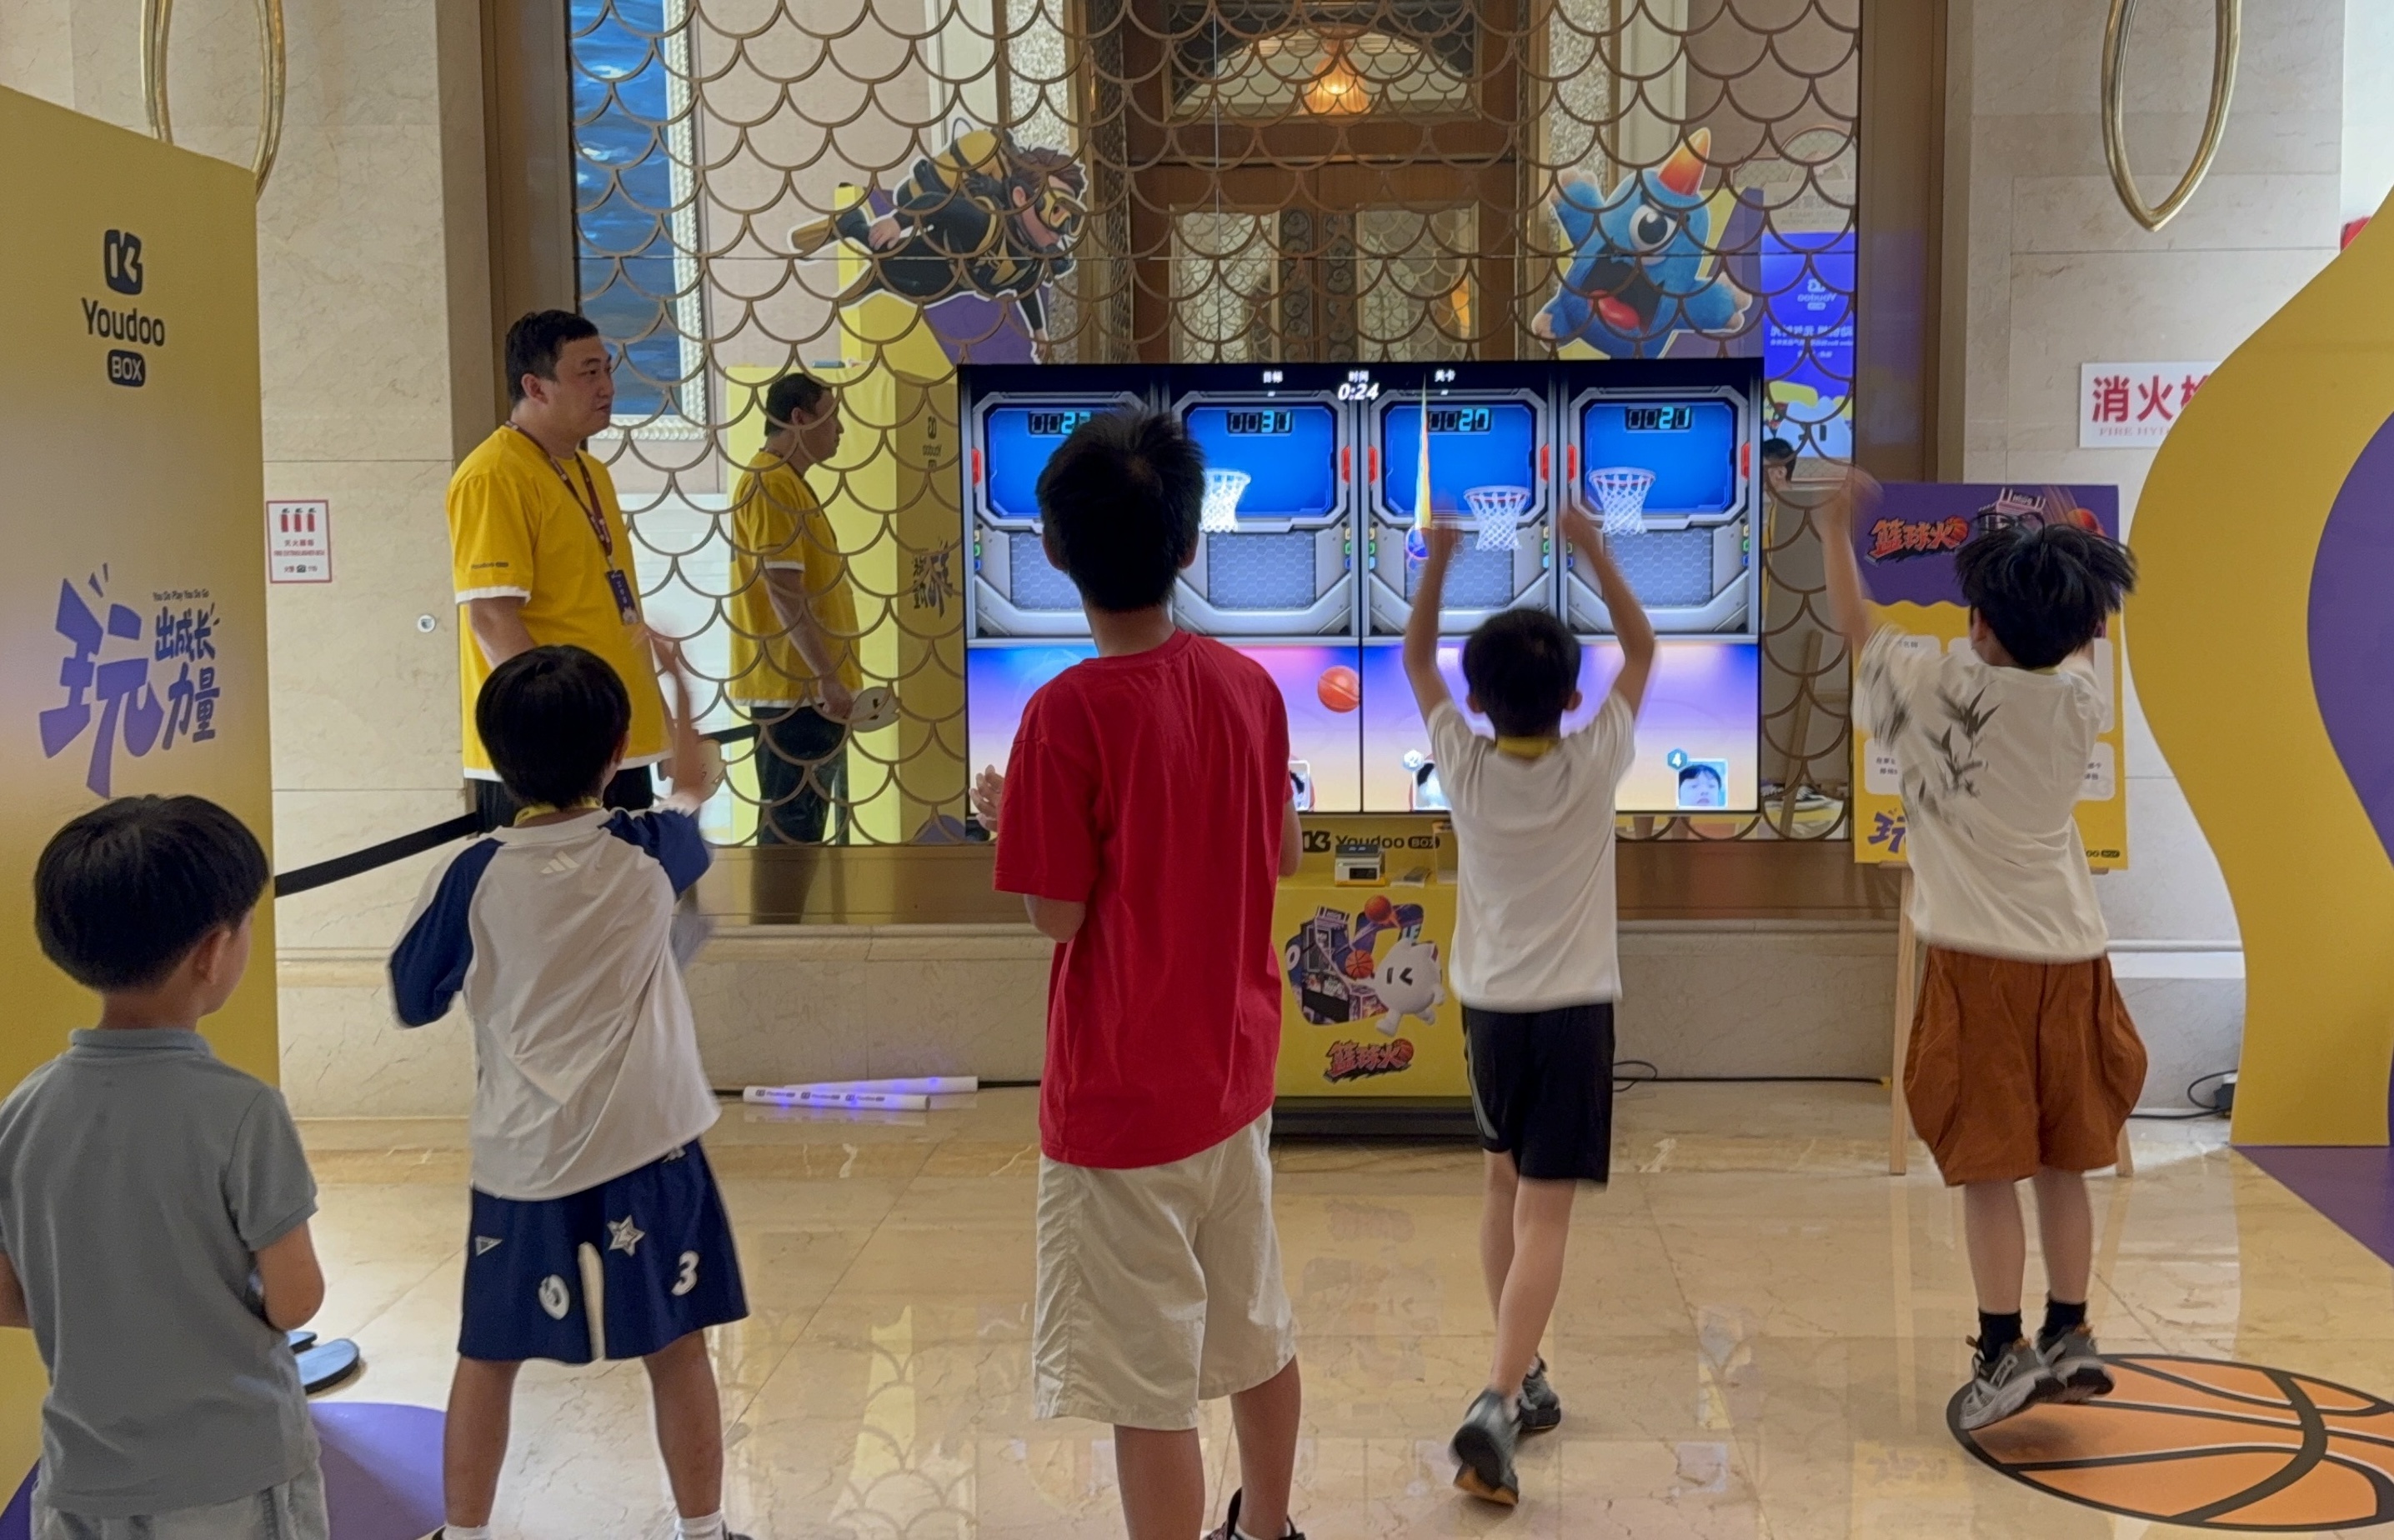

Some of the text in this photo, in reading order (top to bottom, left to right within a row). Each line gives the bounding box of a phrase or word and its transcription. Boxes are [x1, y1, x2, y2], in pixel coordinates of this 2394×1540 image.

[82, 298, 165, 347] Youdoo
[111, 356, 143, 382] BOX
[1348, 371, 1370, 383] 时间
[1338, 382, 1380, 401] 0:24
[2100, 427, 2132, 436] FIRE
[155, 605, 216, 662] 出成长
[39, 578, 164, 799] 玩
[162, 661, 220, 751] 力量
[1671, 752, 1682, 767] 4
[671, 1250, 699, 1296] 3
